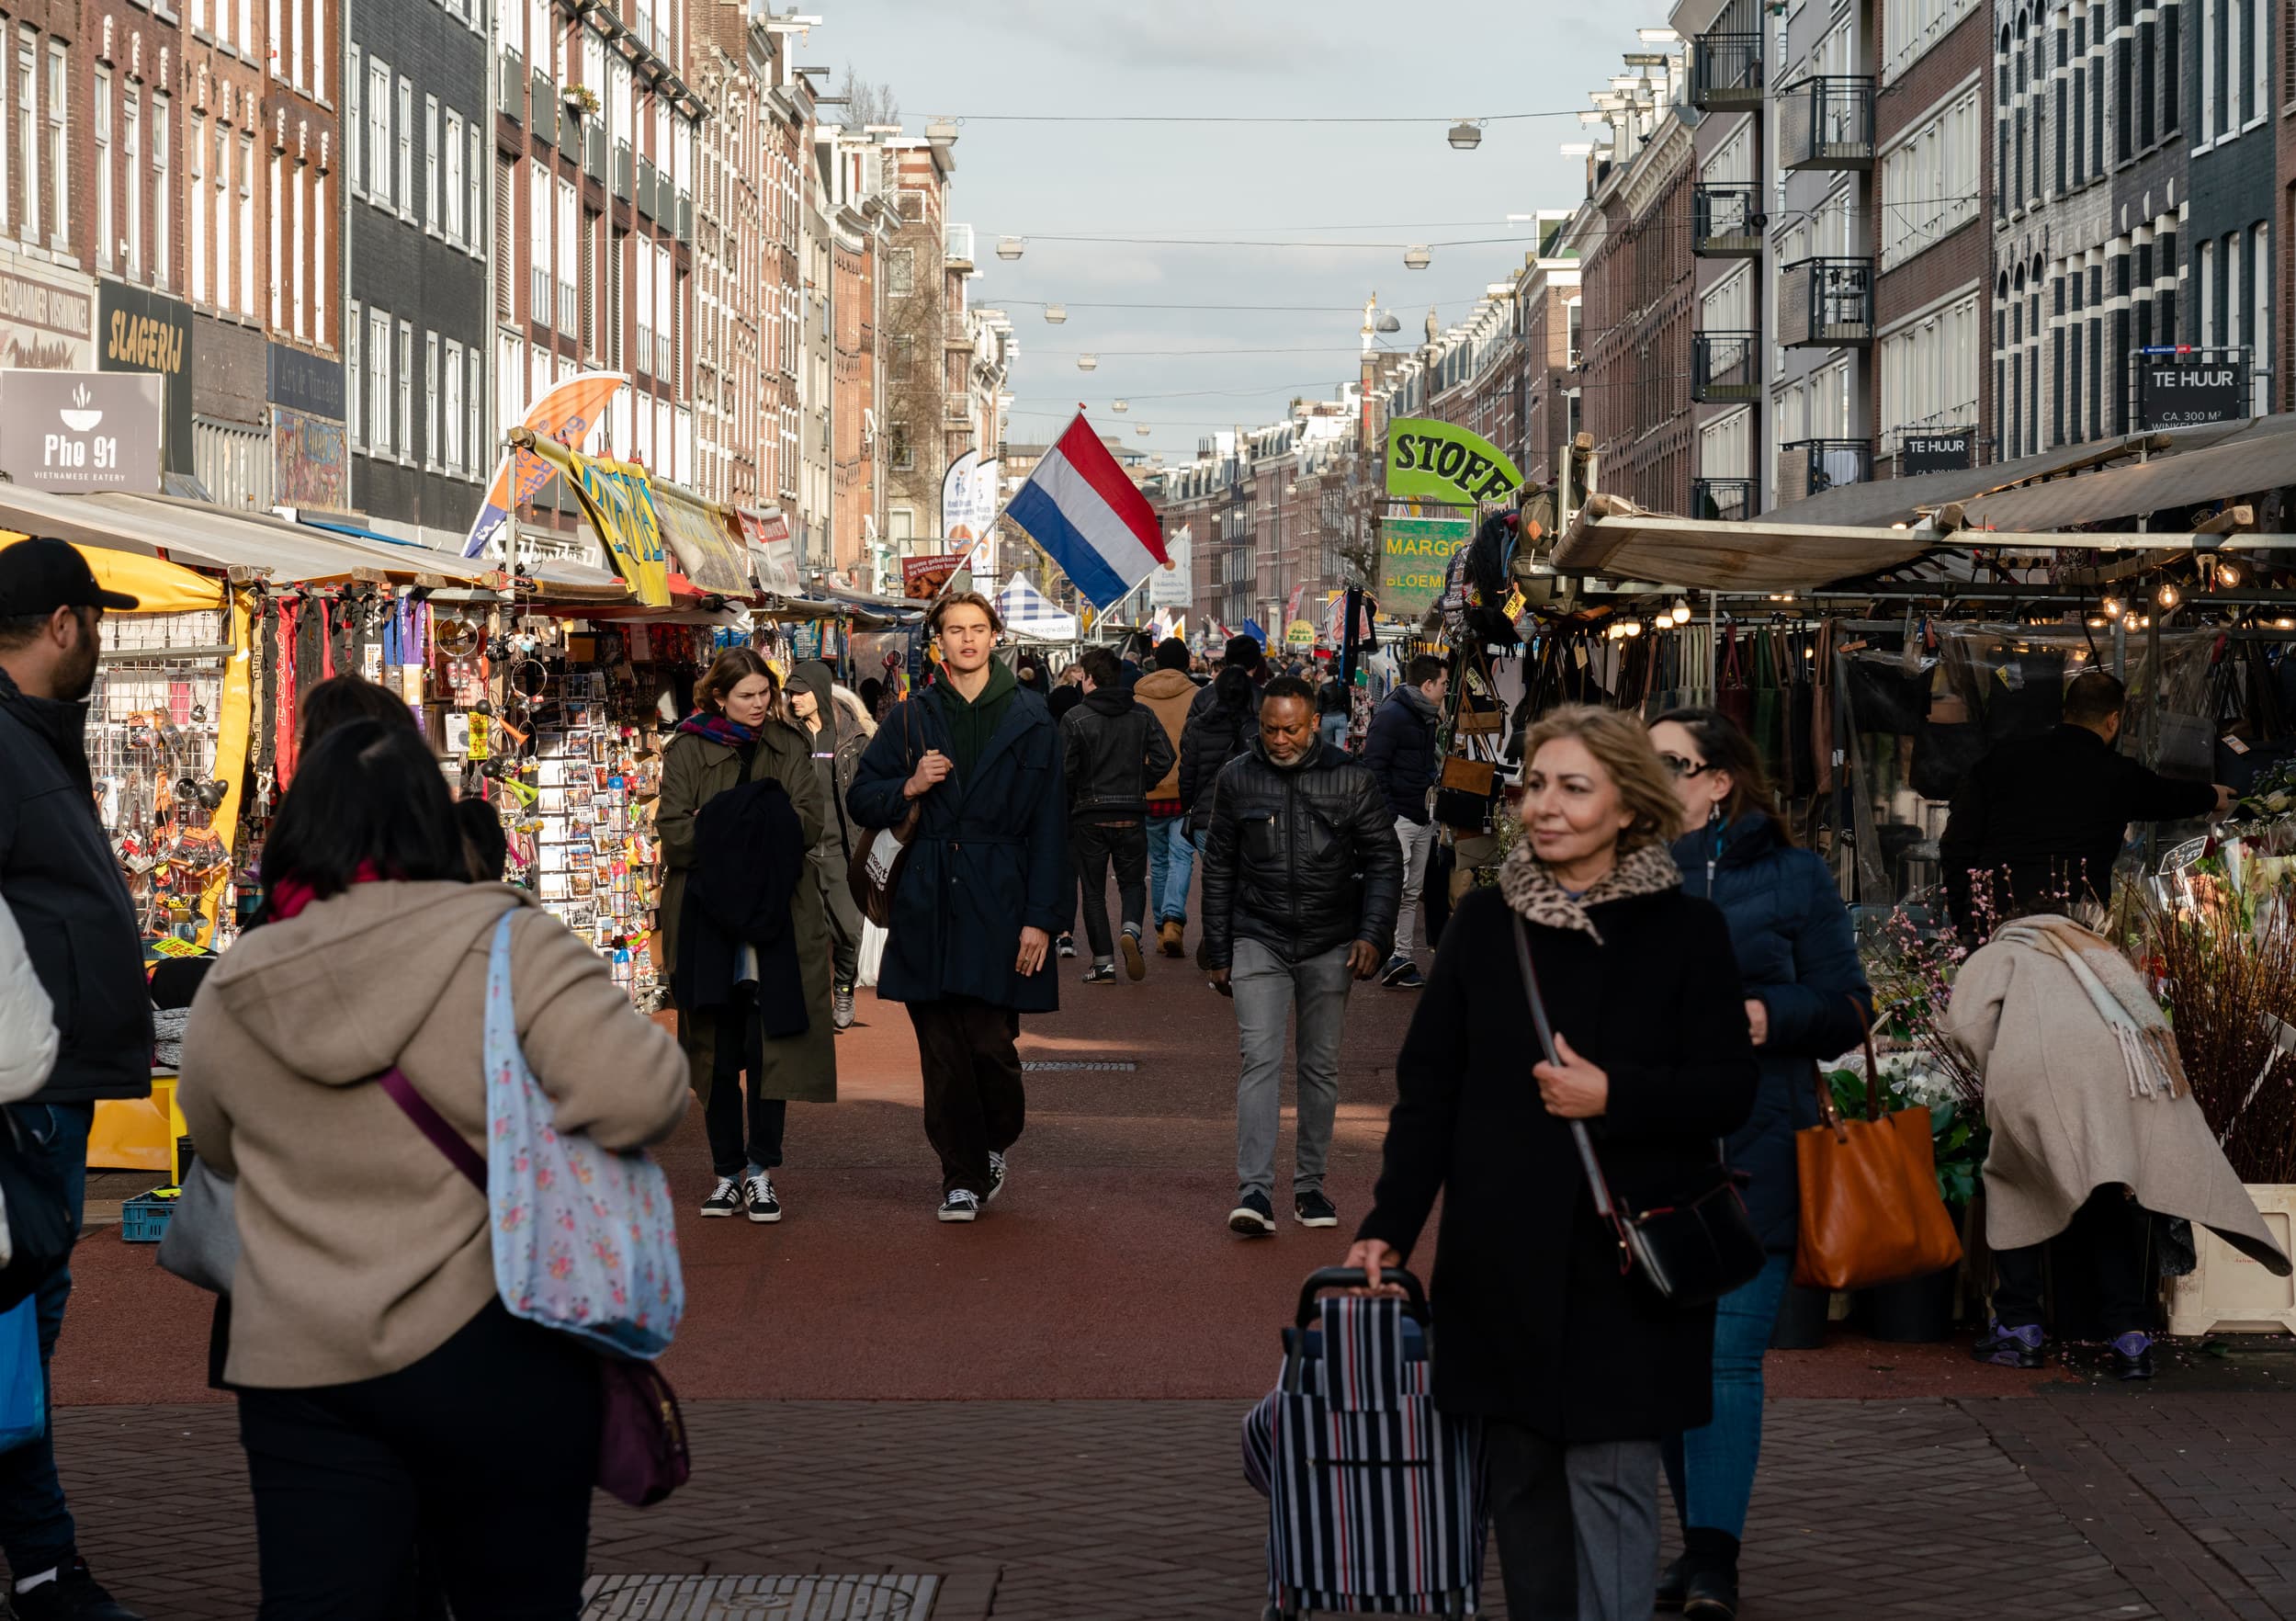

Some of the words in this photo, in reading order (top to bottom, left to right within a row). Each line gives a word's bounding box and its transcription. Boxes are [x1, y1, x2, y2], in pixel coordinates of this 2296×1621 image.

[48, 289, 89, 335] VISWINKEL
[108, 309, 184, 374] SLAGERIJ
[308, 369, 339, 410] Vintage
[2153, 371, 2176, 387] TE
[2180, 370, 2234, 387] HUUR
[2163, 412, 2181, 421] CA.
[2184, 412, 2204, 421] 300
[44, 434, 85, 468] Pho
[94, 436, 117, 469] 91
[1909, 440, 1926, 453] TE
[1928, 439, 1965, 453] HUUR
[34, 470, 89, 482] VIETNAMESE
[92, 473, 126, 482] EATERY
